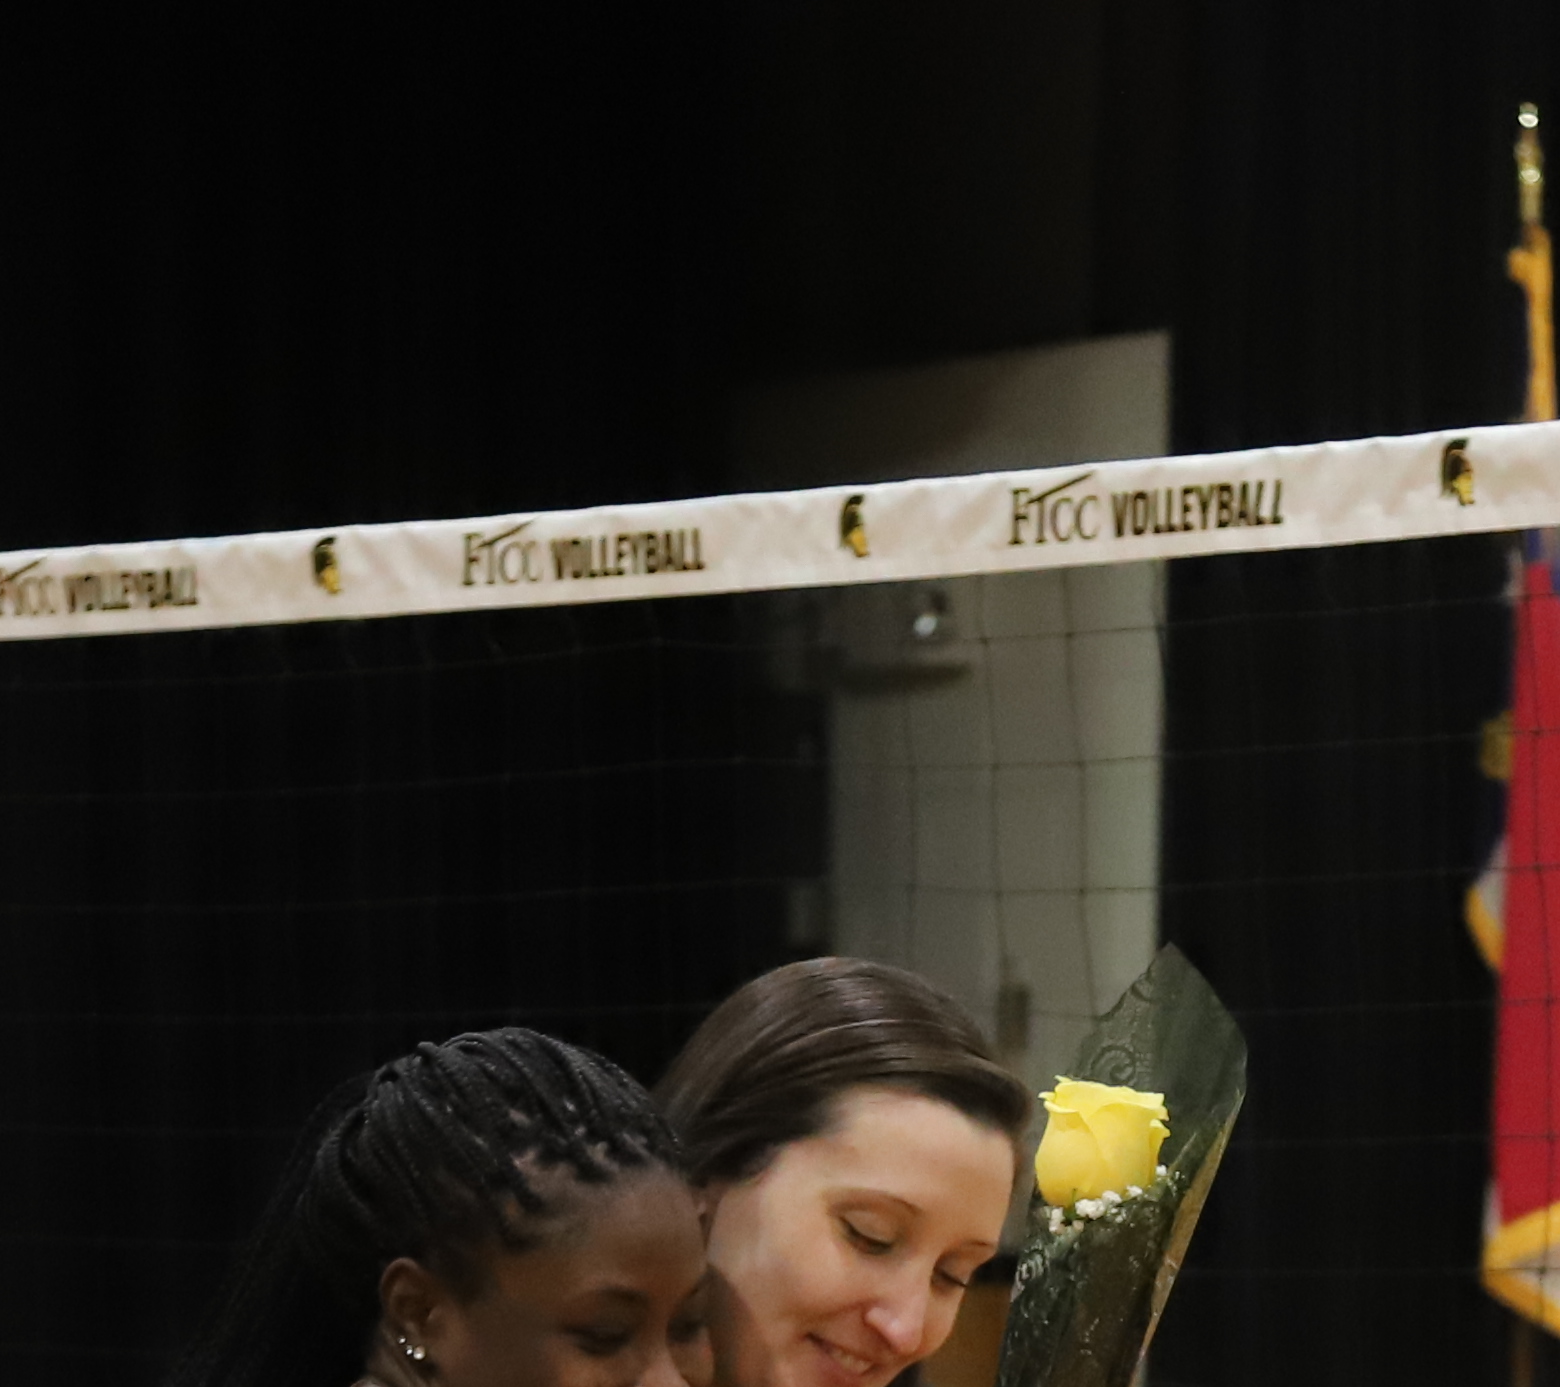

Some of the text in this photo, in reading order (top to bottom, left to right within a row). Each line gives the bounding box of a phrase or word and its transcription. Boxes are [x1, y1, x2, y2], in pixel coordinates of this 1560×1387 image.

[1008, 472, 1285, 547] FTCC VOLLEYBALL
[462, 517, 707, 588] FTCC VOLLEYBALL
[64, 566, 200, 612] VOLLEYBALL
